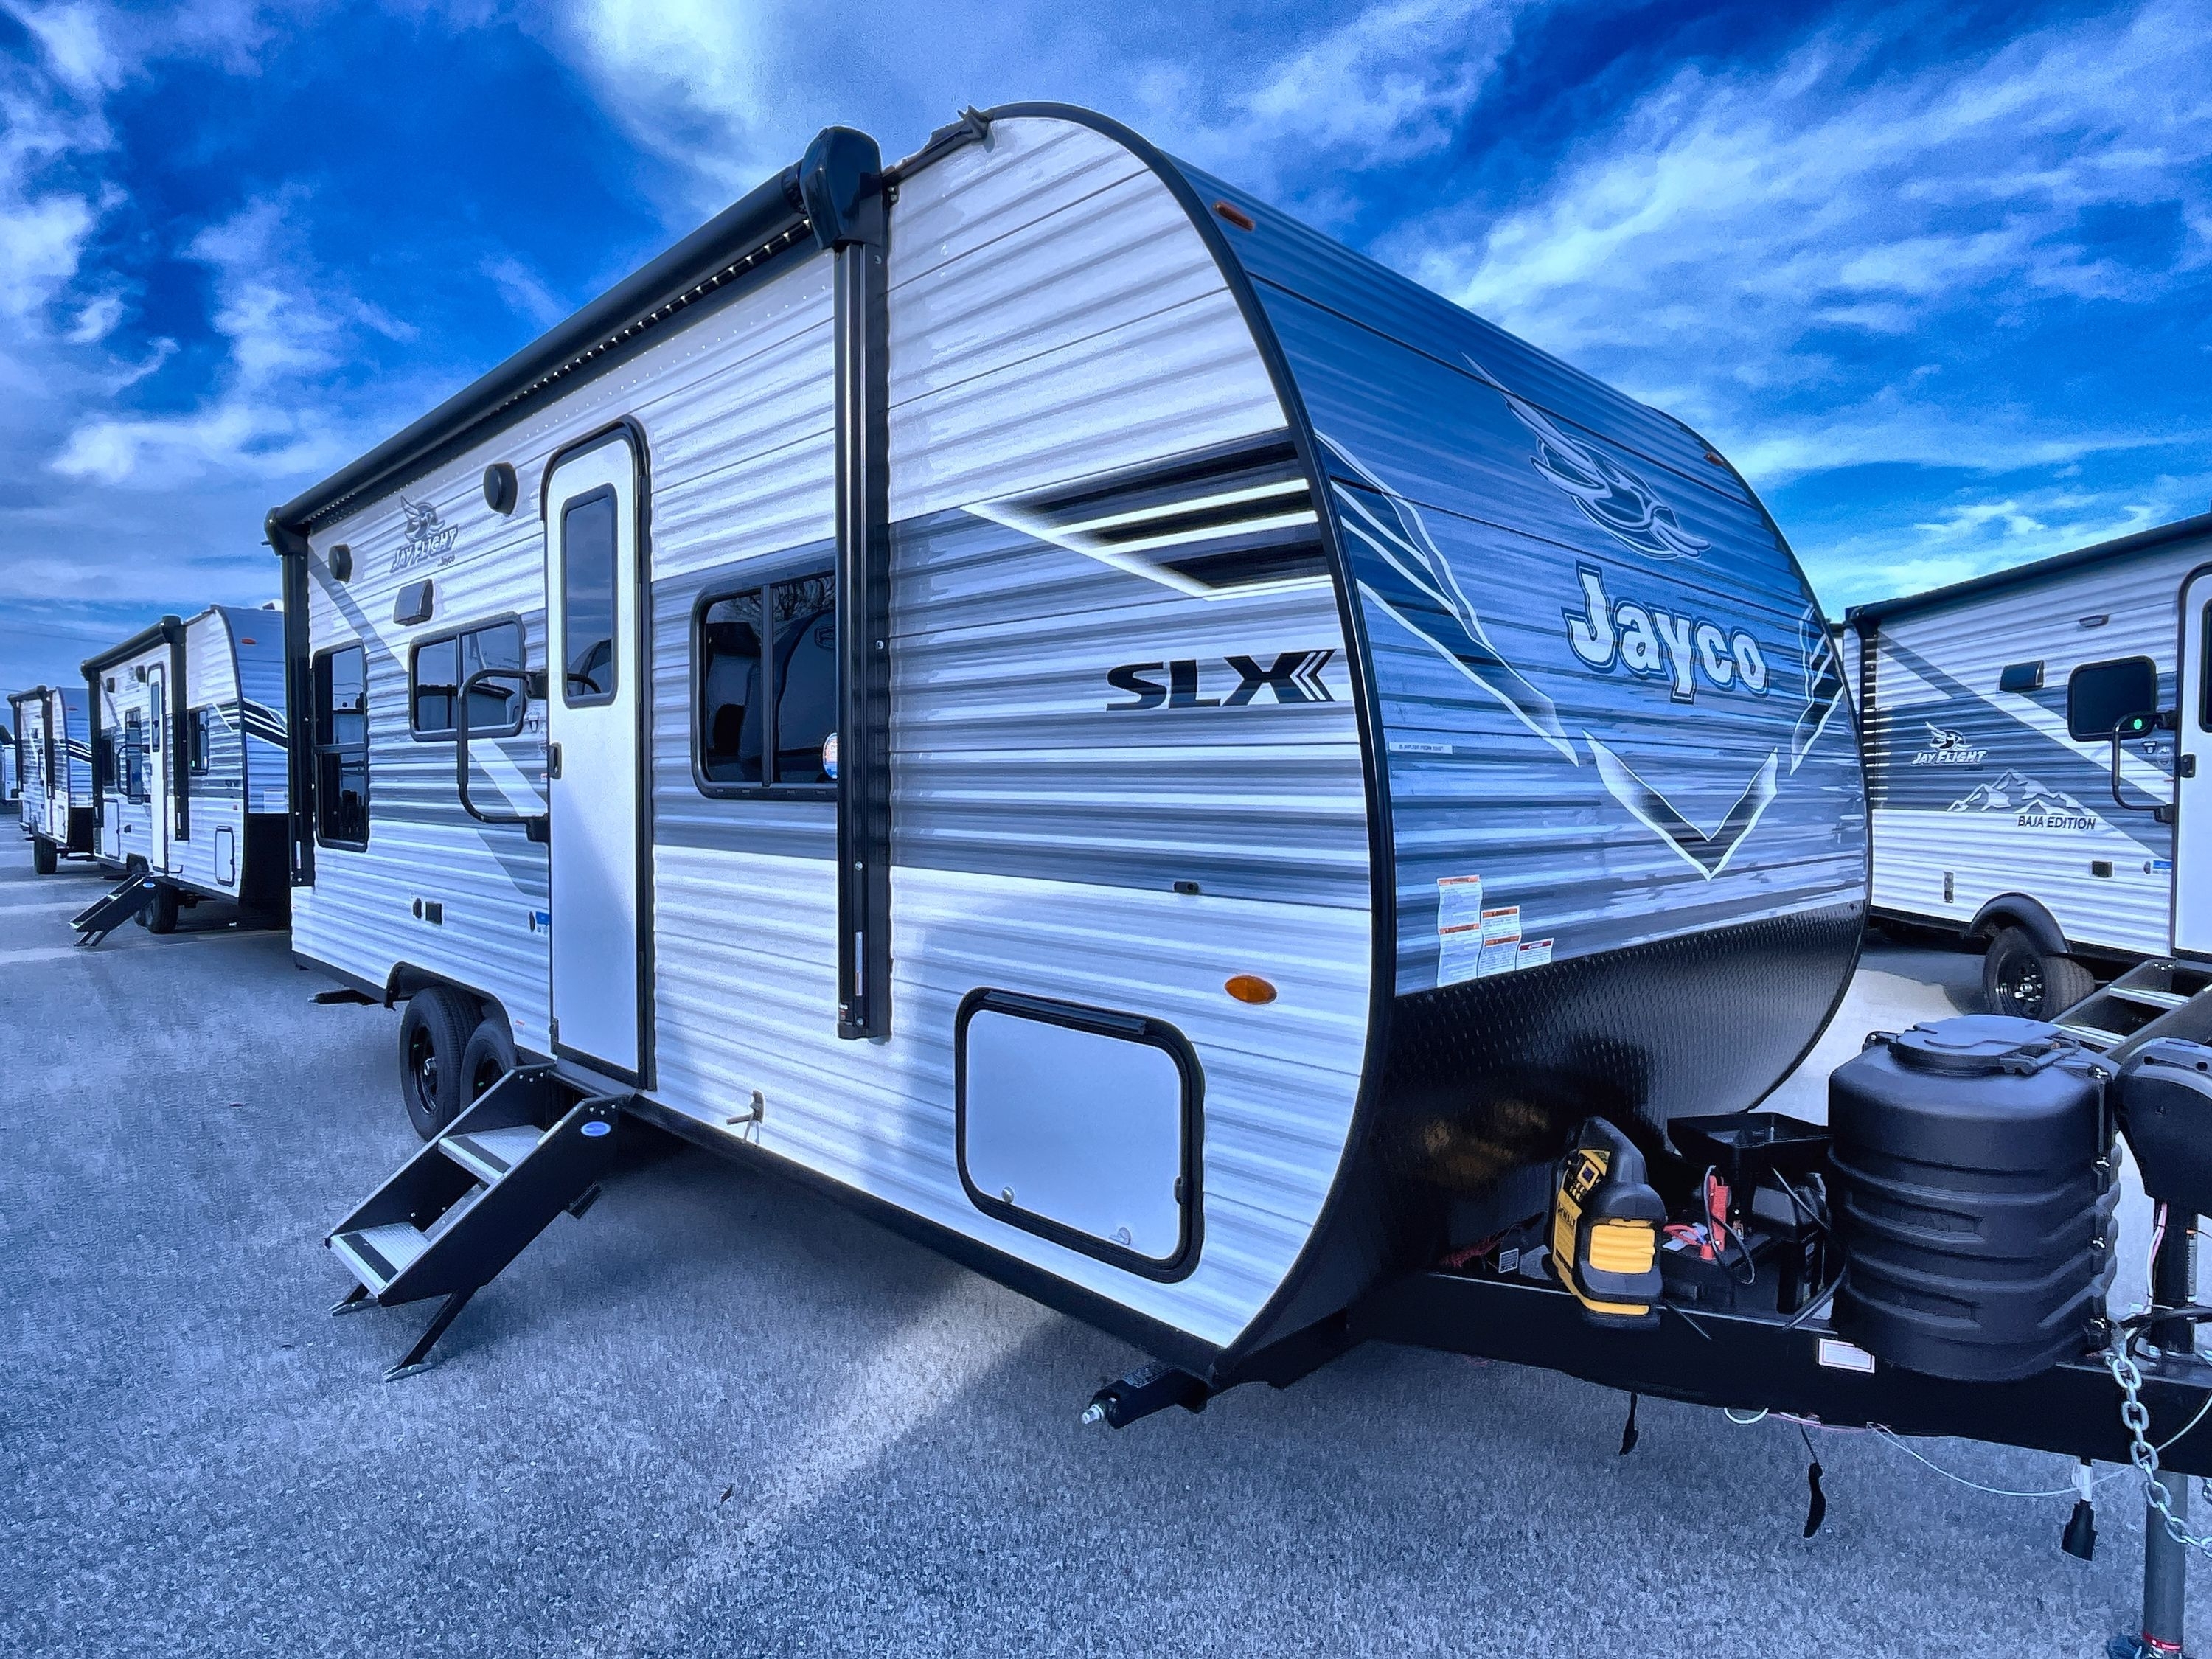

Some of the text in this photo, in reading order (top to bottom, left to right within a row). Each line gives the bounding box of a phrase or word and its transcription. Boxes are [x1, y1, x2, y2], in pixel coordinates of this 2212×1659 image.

[389, 525, 458, 573] JAY FLIGHT
[1562, 560, 1768, 703] Jayco
[1107, 648, 1336, 711] SLX
[1910, 750, 1988, 765] JAY FLIGHT
[2018, 816, 2096, 830] BAJA EDITION
